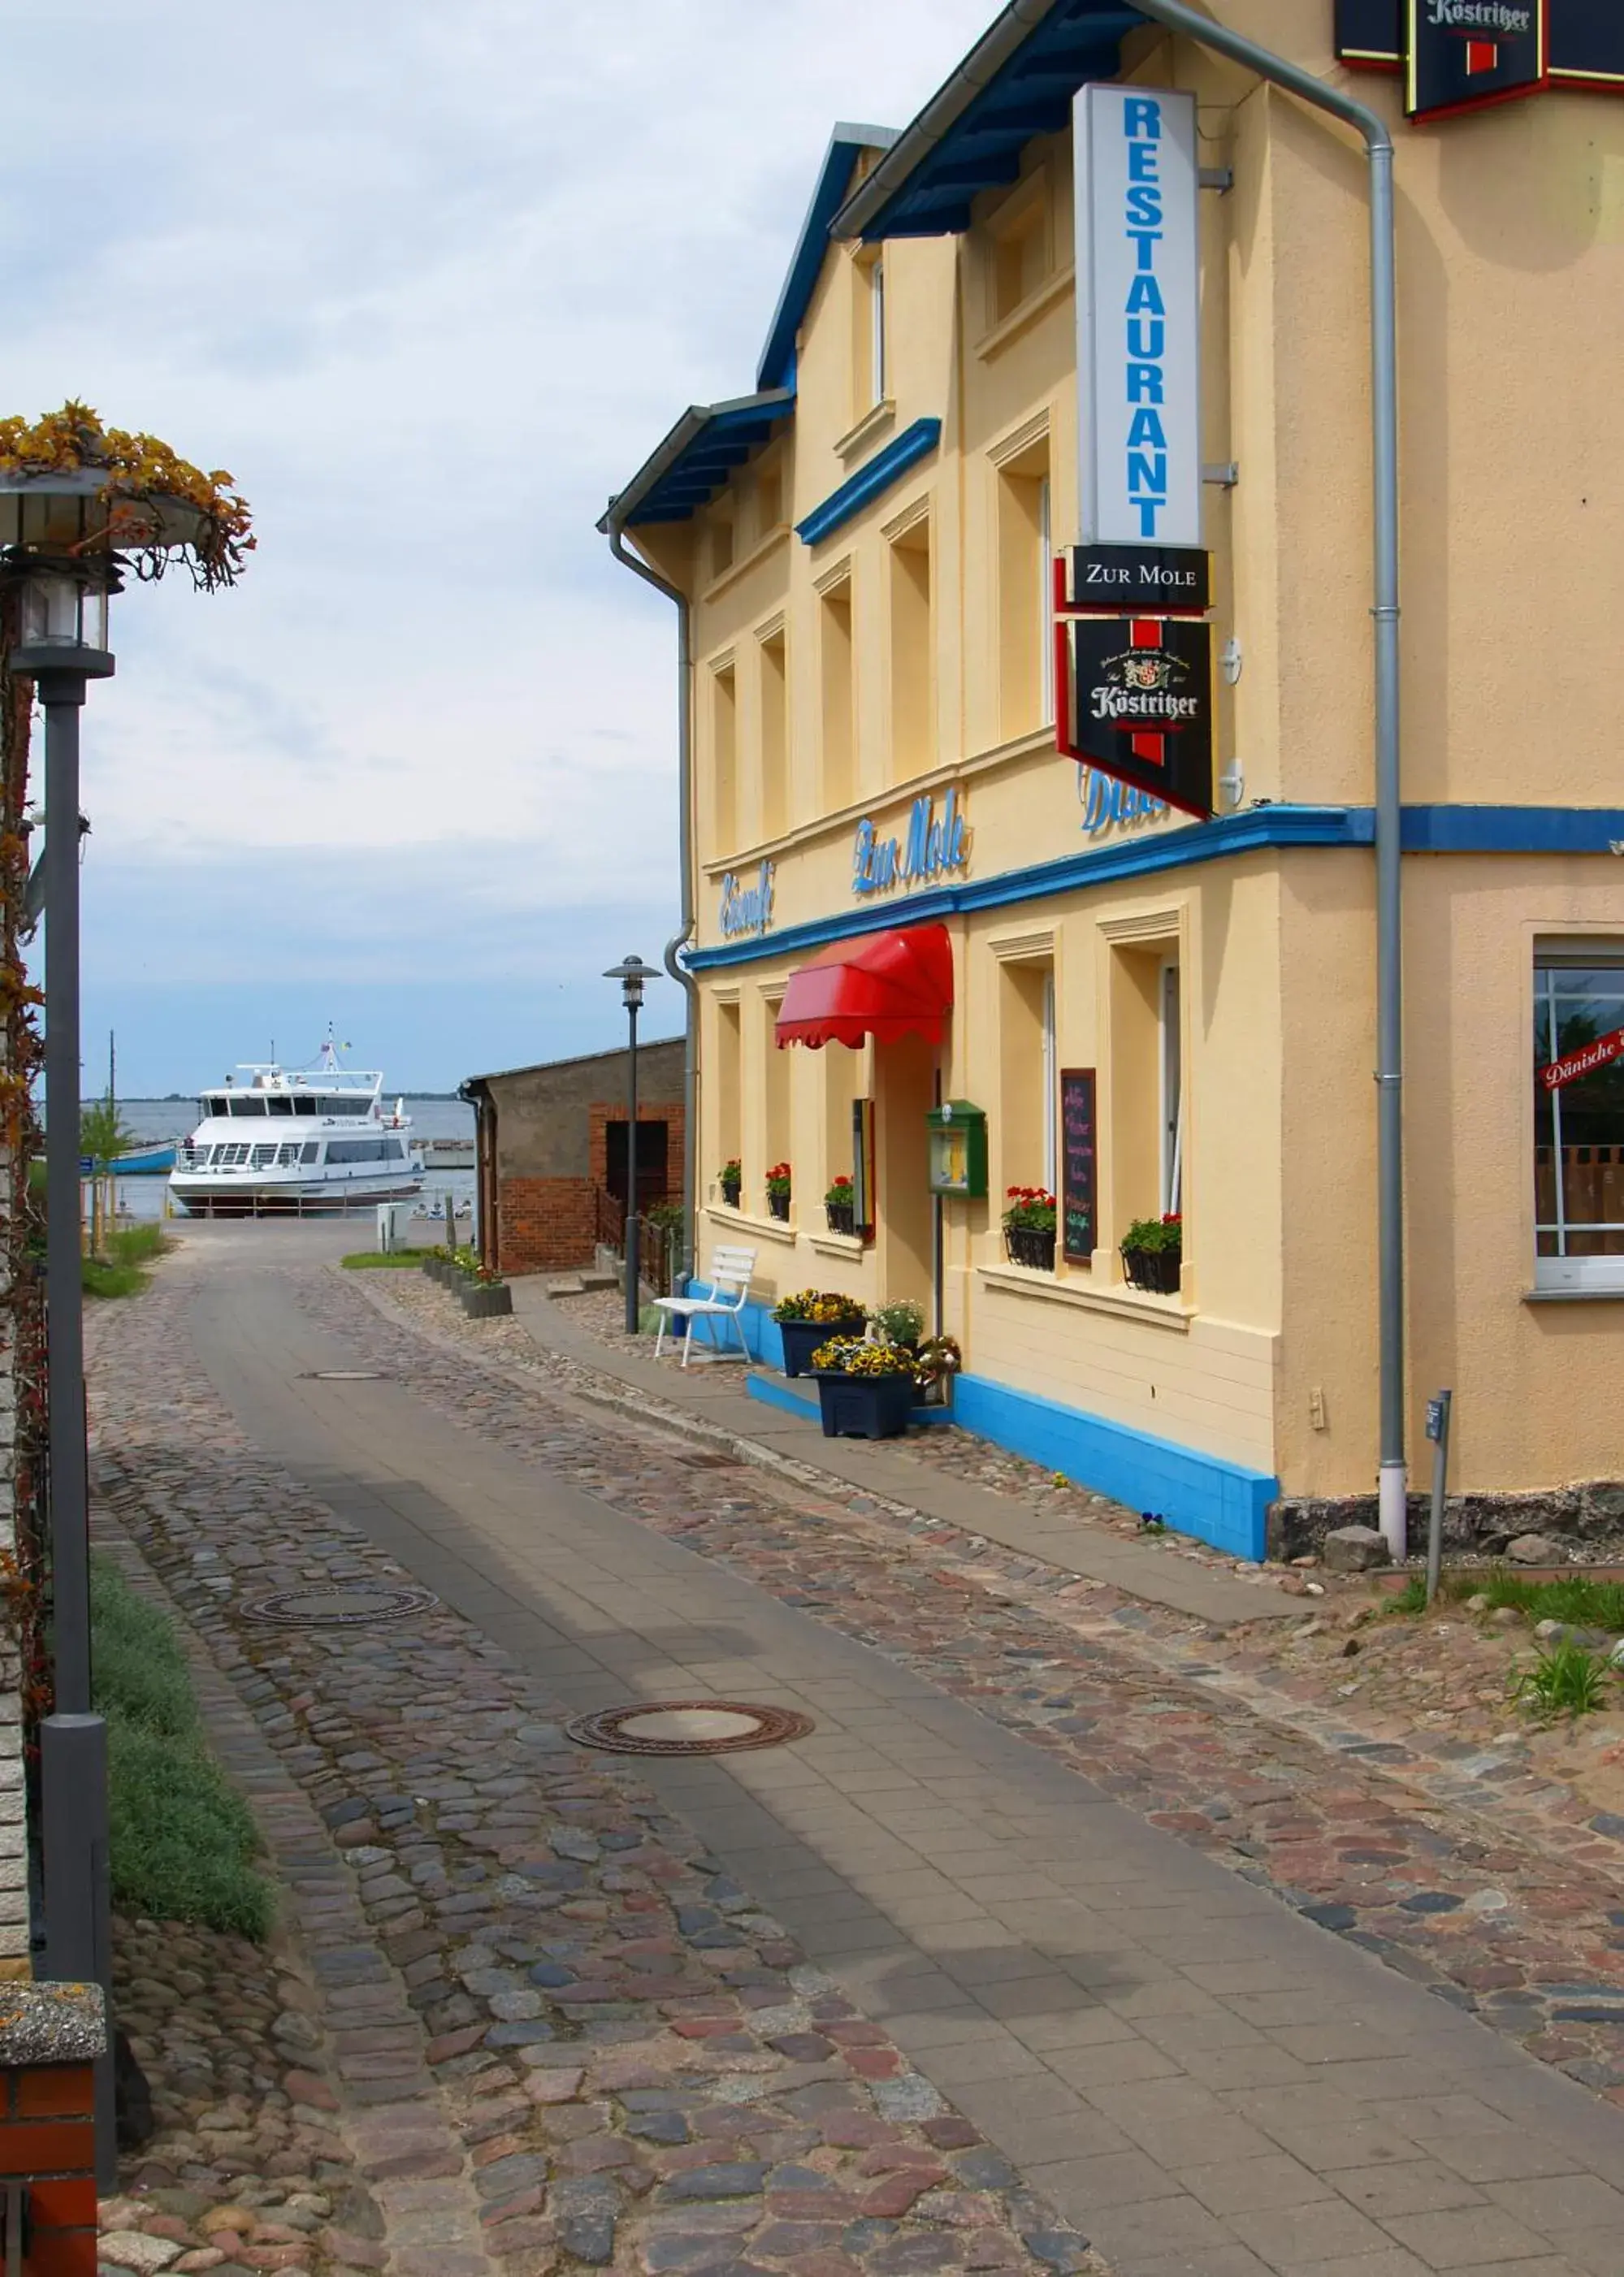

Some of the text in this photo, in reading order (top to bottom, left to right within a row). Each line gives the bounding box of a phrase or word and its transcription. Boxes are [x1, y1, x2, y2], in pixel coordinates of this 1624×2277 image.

[1124, 97, 1167, 538] RESTAURANT
[1090, 686, 1198, 721] Köstritzer
[1545, 1042, 1616, 1085] Dänische
